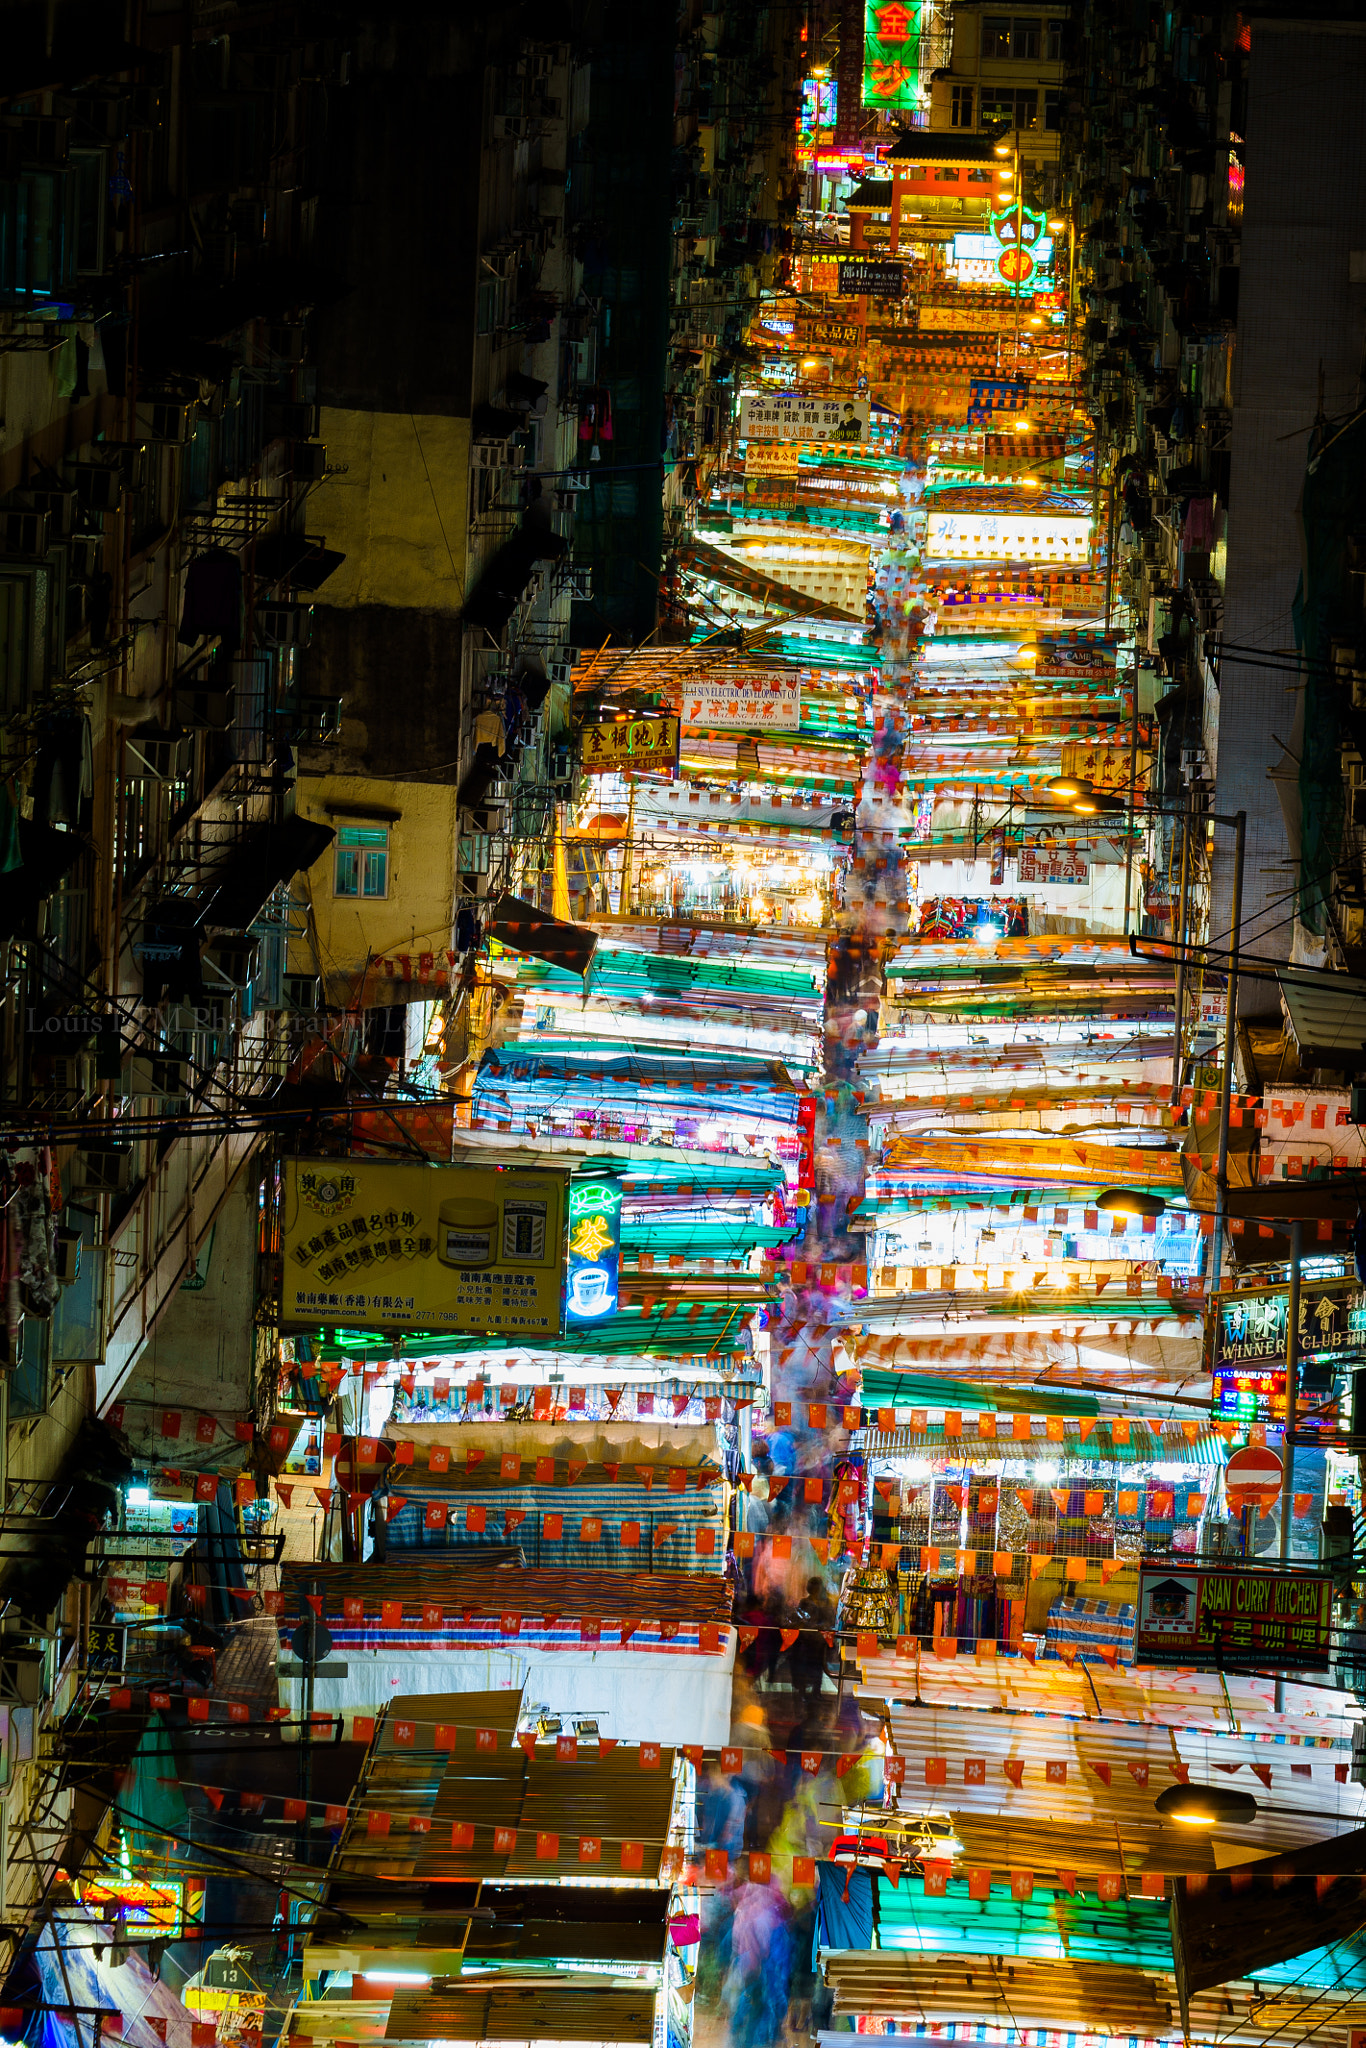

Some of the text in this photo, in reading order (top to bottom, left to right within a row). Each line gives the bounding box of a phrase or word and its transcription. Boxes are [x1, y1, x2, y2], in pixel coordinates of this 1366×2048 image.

[872, 2, 916, 96] 金沙
[1003, 251, 1030, 280] 押
[748, 410, 780, 423] 中港車牌
[698, 687, 710, 697] SUN
[711, 687, 741, 698] ELECTRIC
[588, 721, 673, 753] 金楓地產
[587, 754, 600, 762] GOLD
[646, 750, 664, 758] AGENCY
[639, 758, 664, 767] 4168
[296, 1210, 415, 1263] 止痛產品聞名中外
[294, 1306, 368, 1318] www.lingnam.com.hk
[1222, 1339, 1287, 1360] WINNER
[1302, 1332, 1342, 1350] CLUB
[1237, 1378, 1275, 1391] 手机
[1200, 1577, 1319, 1616] ASIAN CURRY KITCHEN
[222, 1969, 238, 1983] 13
